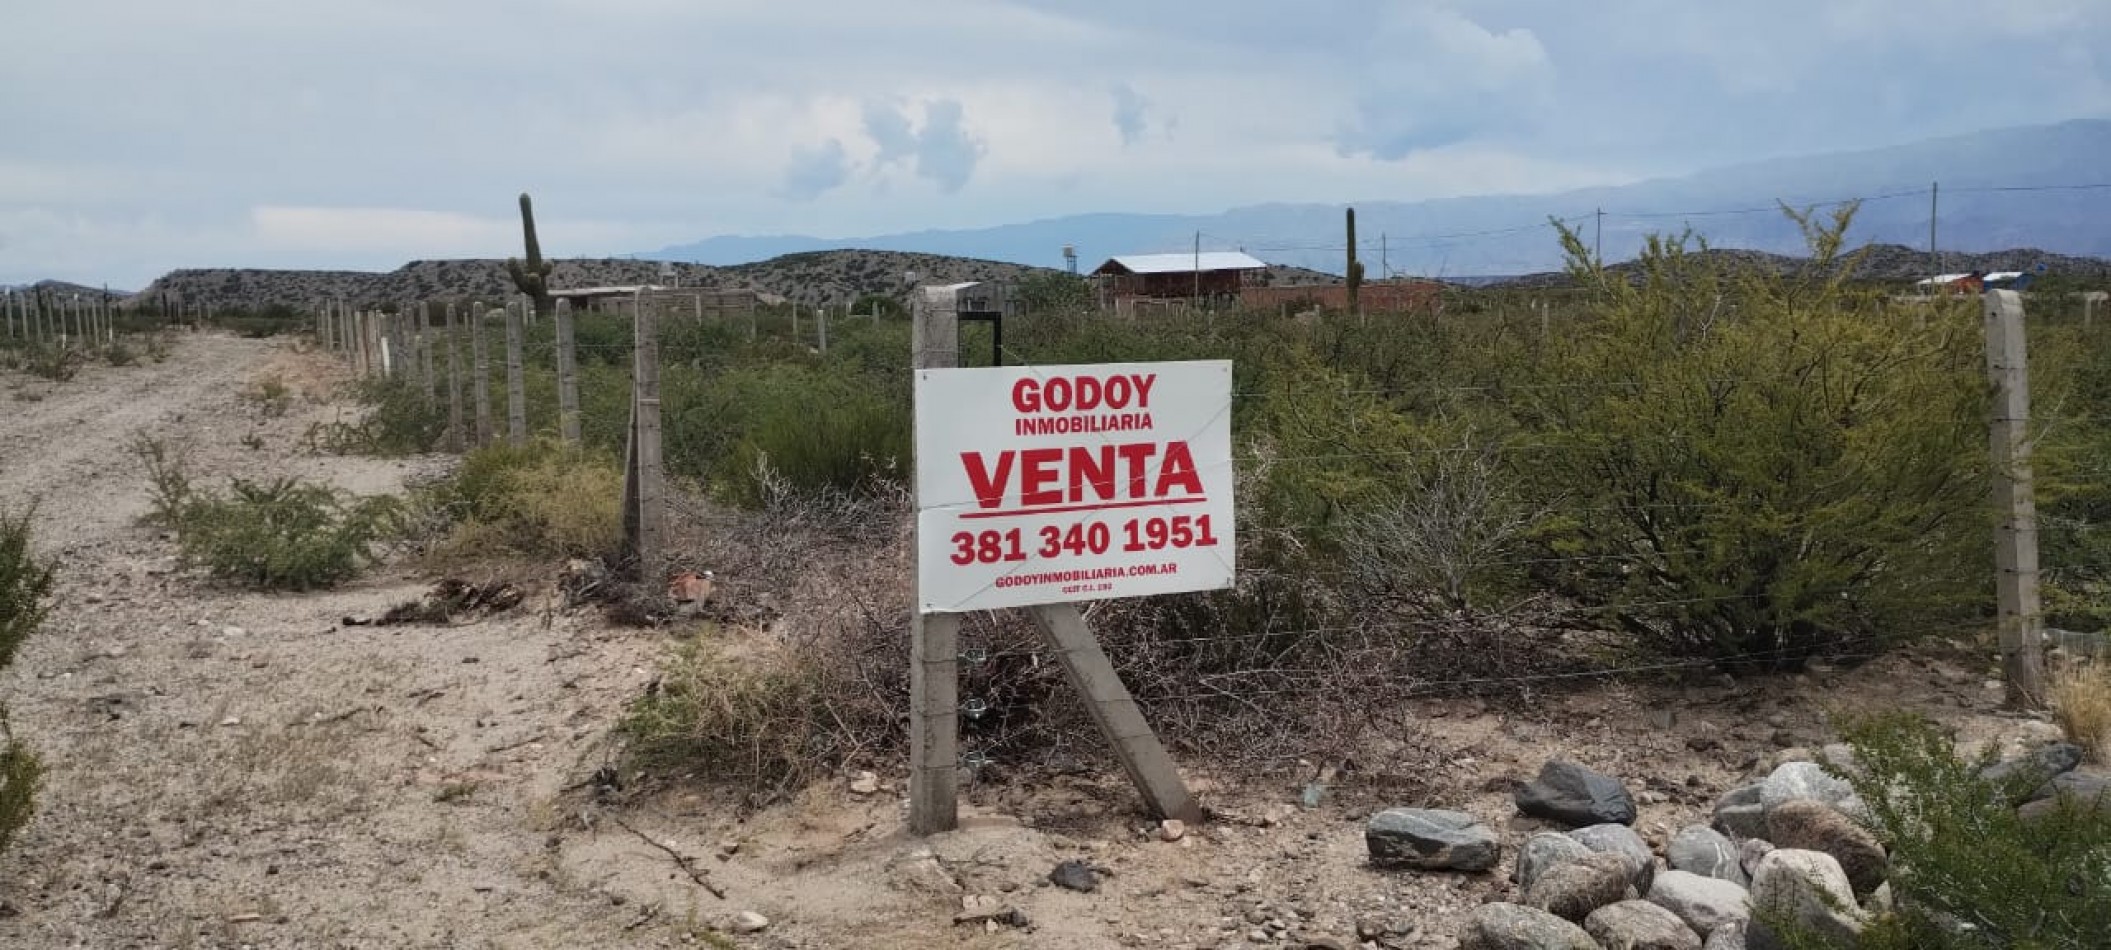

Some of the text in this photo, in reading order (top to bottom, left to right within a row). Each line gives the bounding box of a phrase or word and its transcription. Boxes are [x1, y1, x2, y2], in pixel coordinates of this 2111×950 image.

[1012, 374, 1156, 413] GODOY
[1014, 413, 1153, 436] INMOBILIARIA
[960, 440, 1204, 509] VENTA
[950, 514, 1218, 566] 381 340 1951
[995, 563, 1178, 588] GODOYINMOBILIARIA.COM.AR
